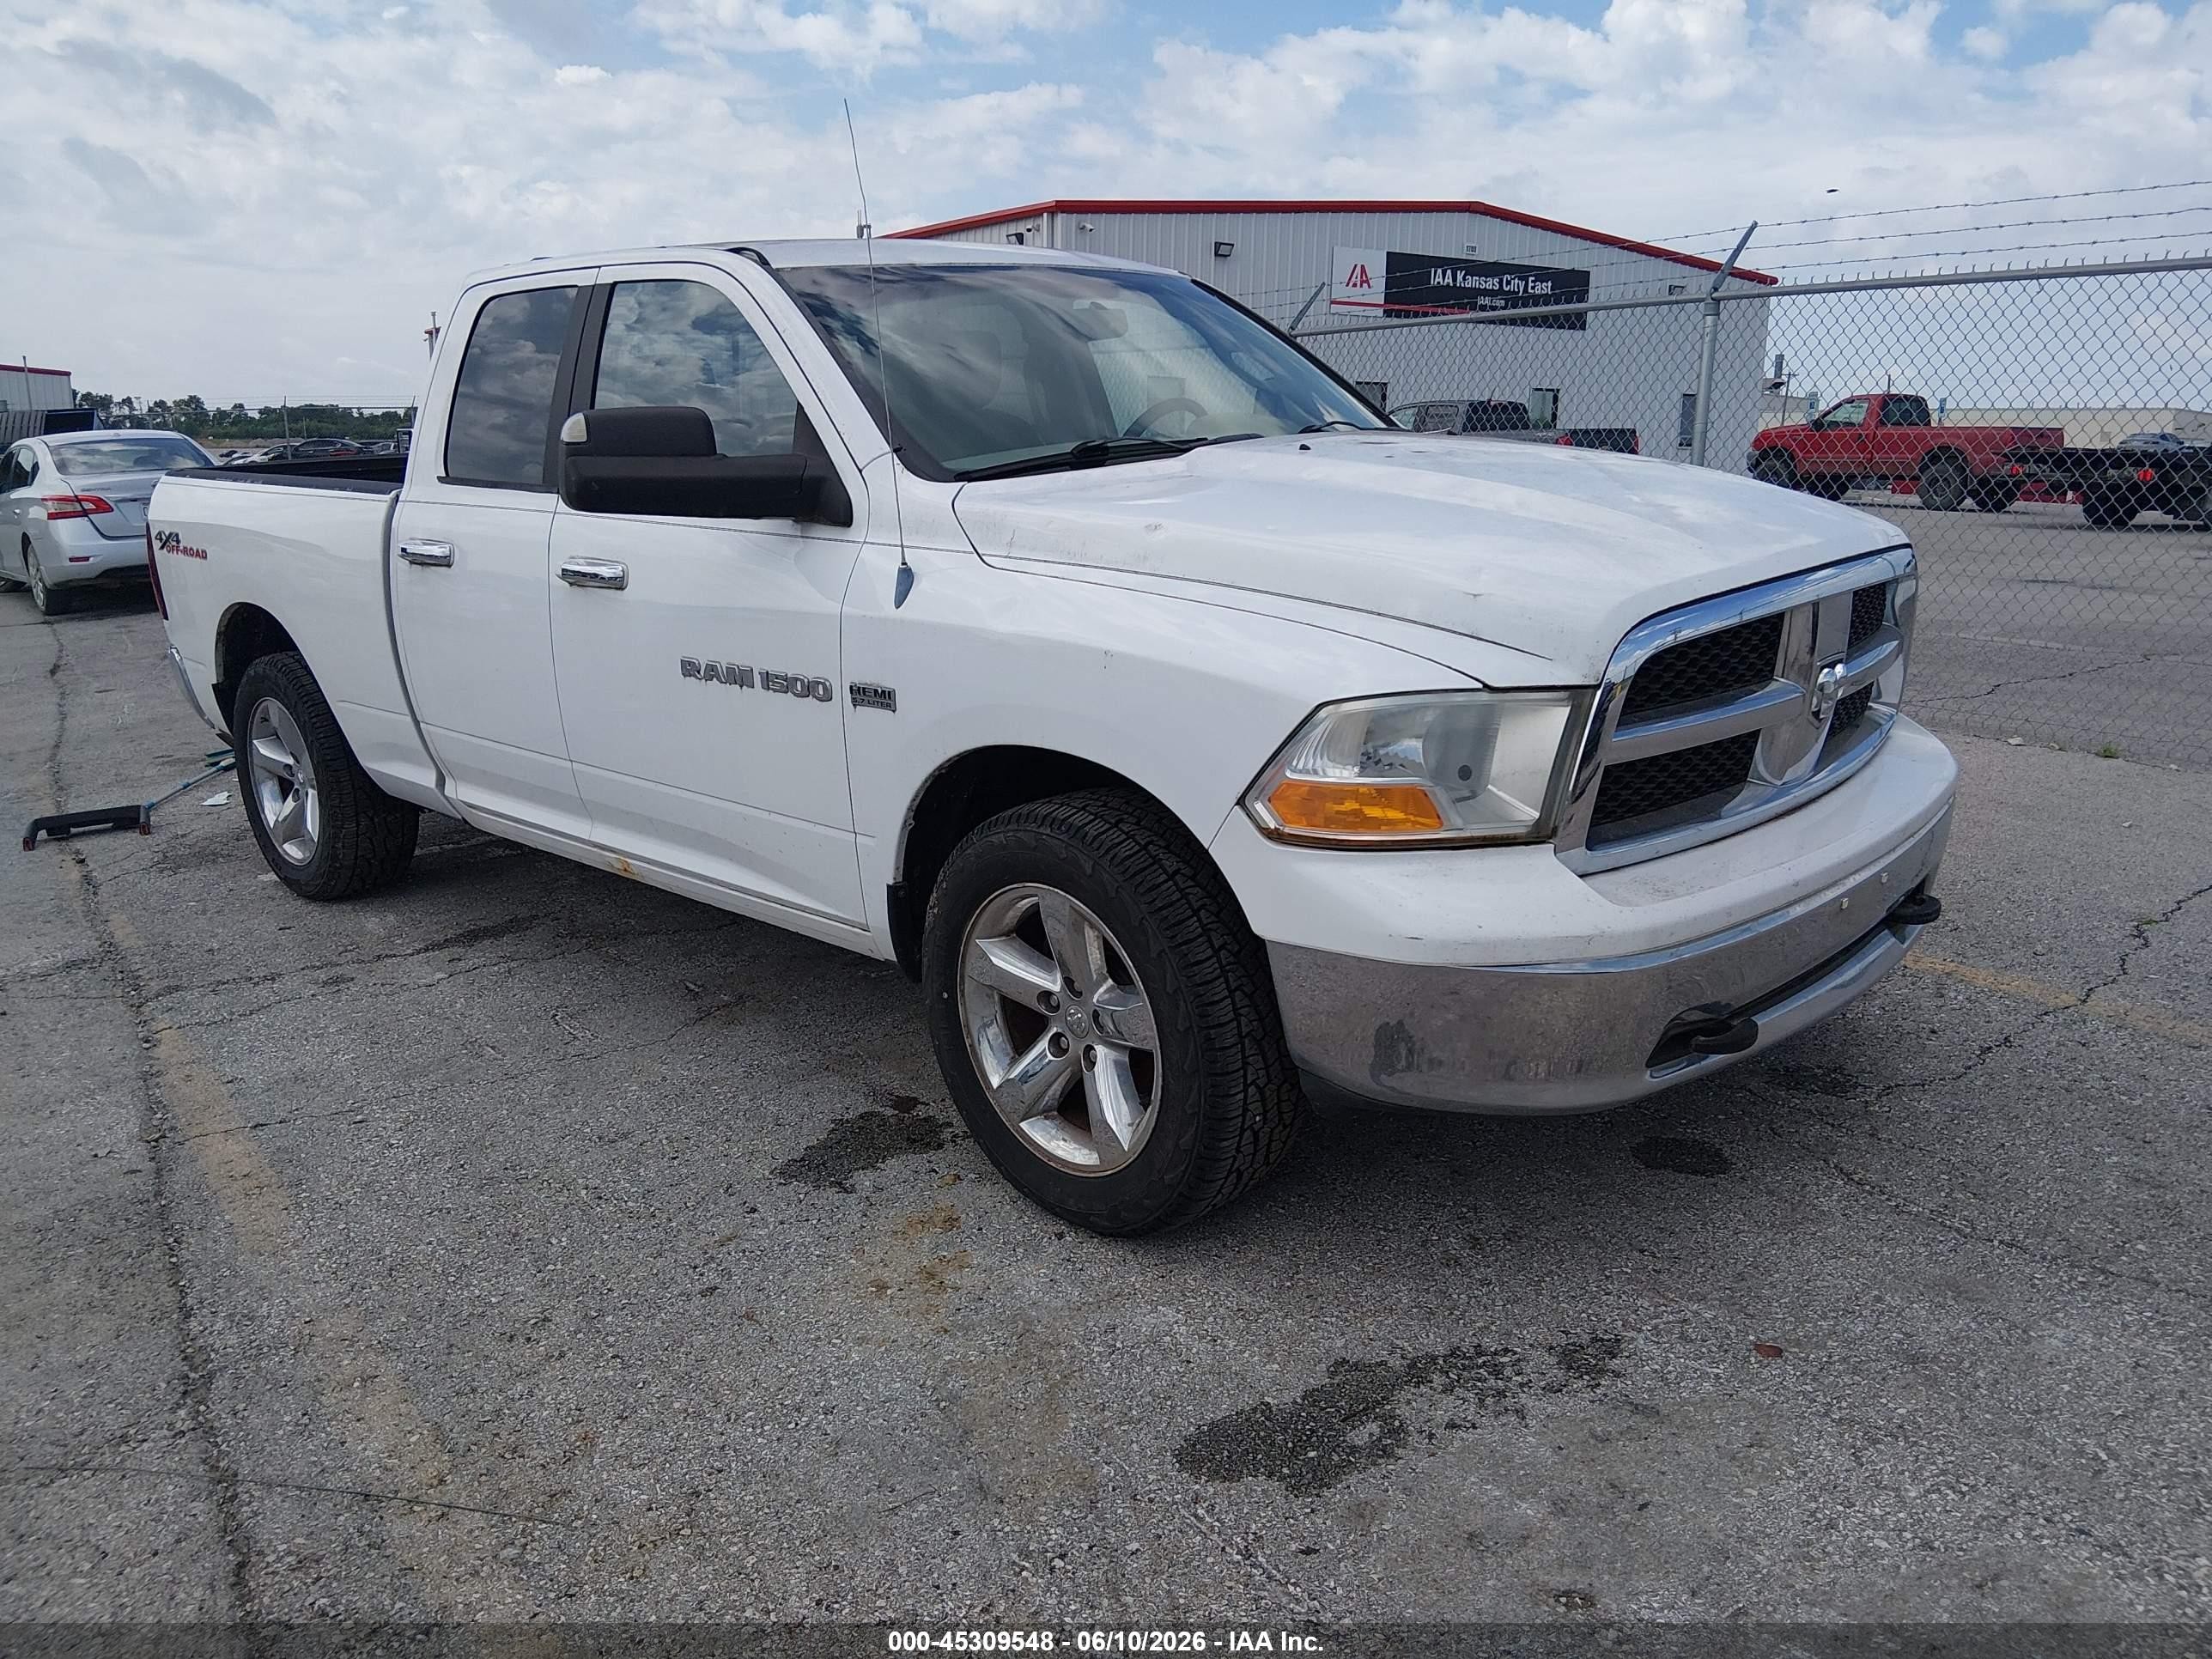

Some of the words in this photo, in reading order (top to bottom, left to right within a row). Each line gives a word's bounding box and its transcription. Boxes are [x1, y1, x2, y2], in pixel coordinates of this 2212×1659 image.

[1431, 267, 1453, 286] IAA
[1456, 270, 1499, 290] Kansas
[1503, 274, 1525, 295] City
[1528, 276, 1552, 295] East
[166, 544, 208, 561] OFF-ROAD
[680, 656, 755, 690] RAM
[758, 668, 833, 702] 1500
[849, 685, 893, 701] HEMI
[852, 696, 866, 705] 5.7
[867, 699, 892, 708] LITER
